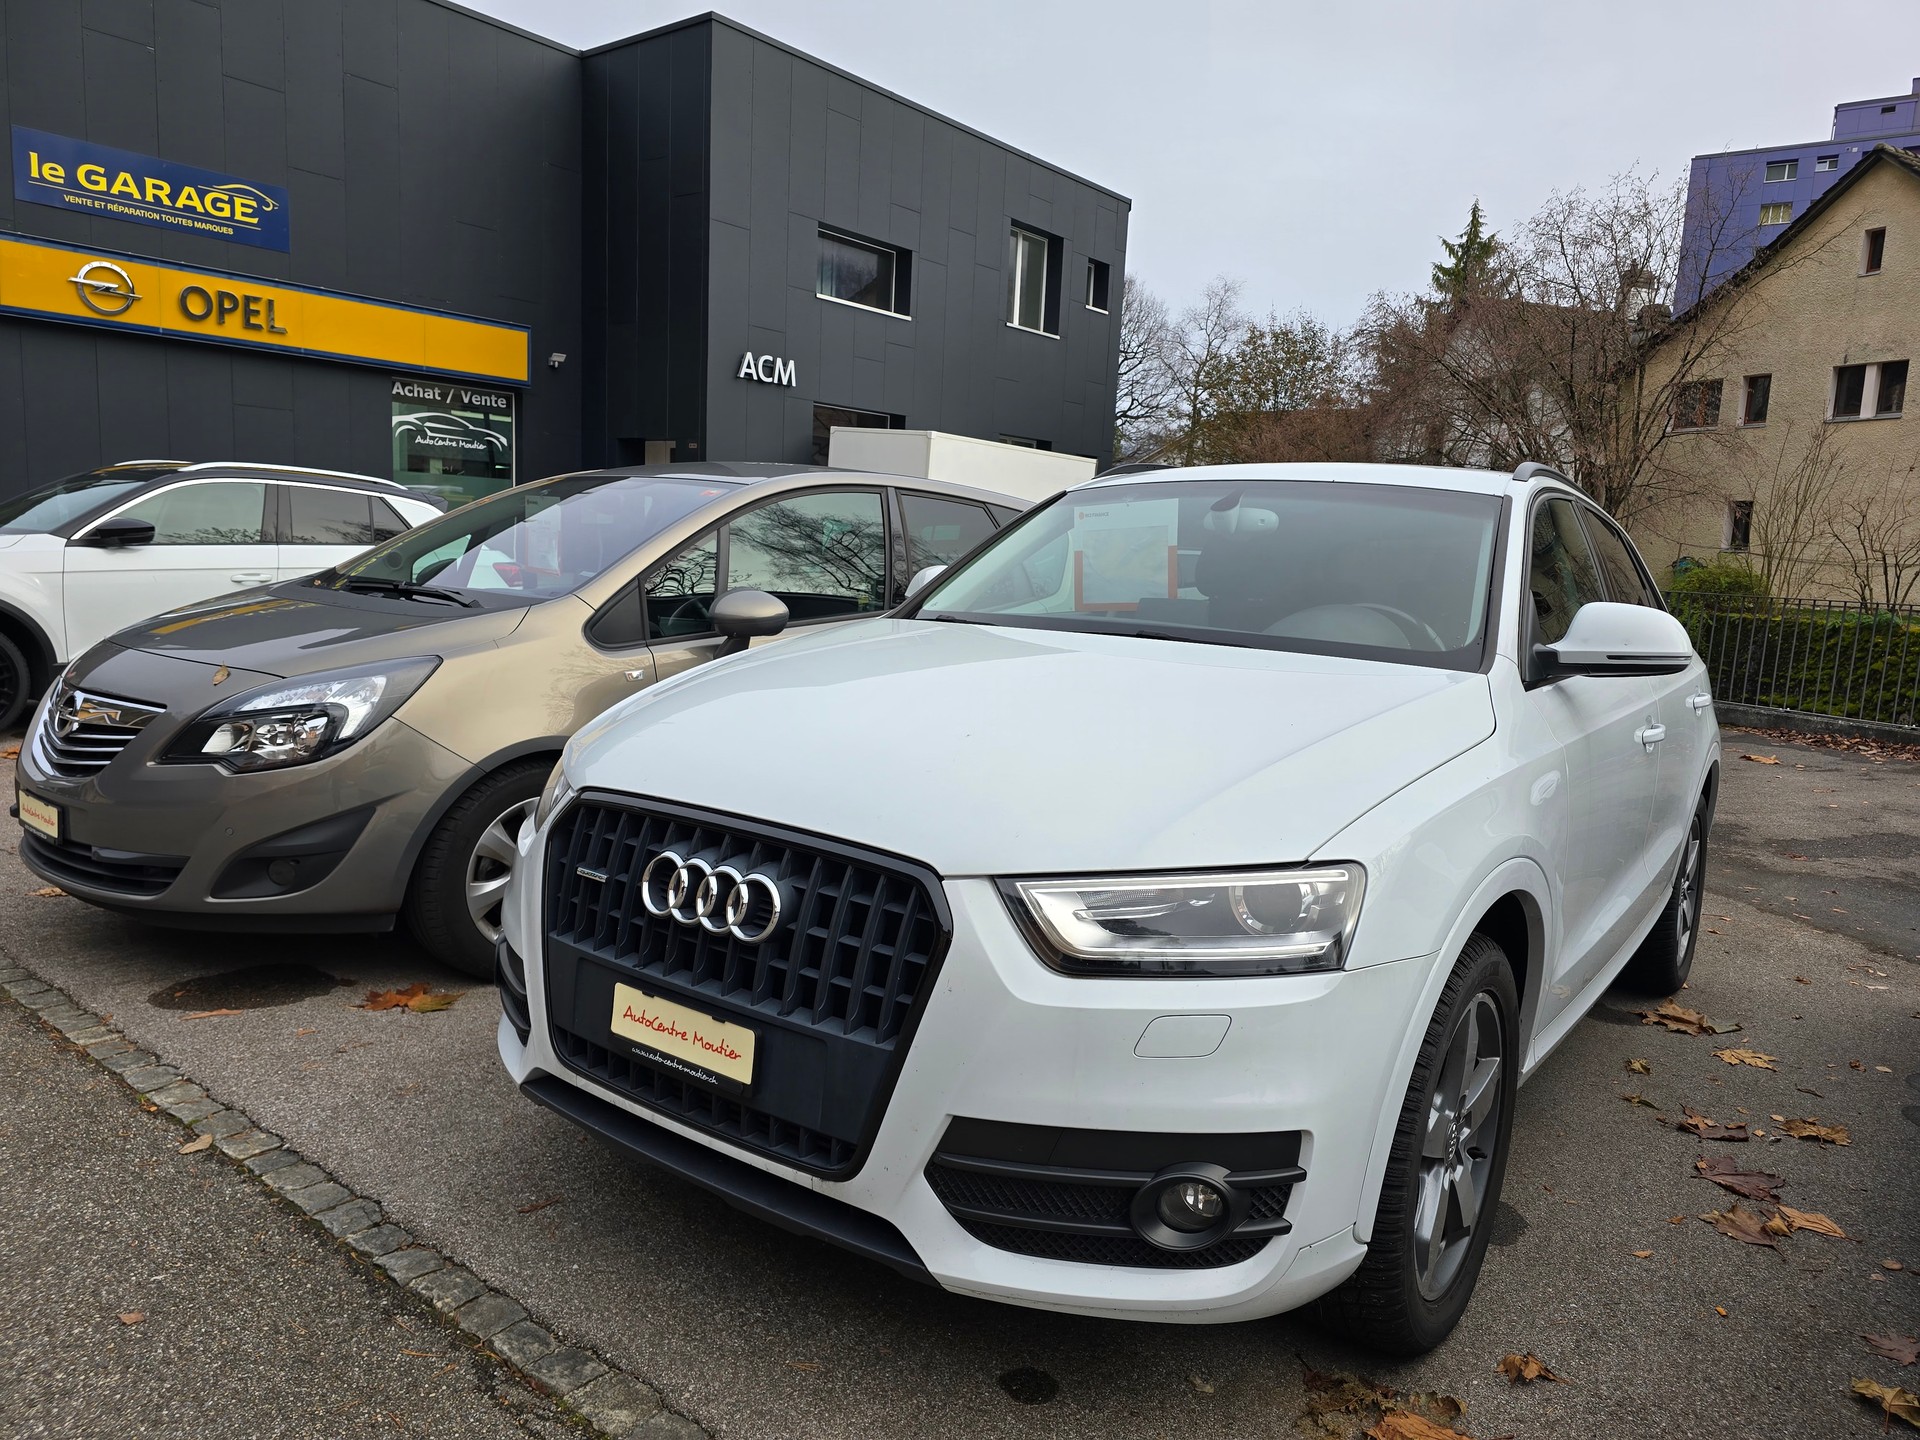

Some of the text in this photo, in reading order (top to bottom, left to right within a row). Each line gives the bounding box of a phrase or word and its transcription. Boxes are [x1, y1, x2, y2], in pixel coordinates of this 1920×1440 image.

[28, 151, 260, 224] le GARAGE
[63, 194, 234, 236] VENTE ET RÉPARATION TOUTES MARQUES
[179, 285, 289, 335] OPEL
[737, 351, 797, 387] ACM
[392, 382, 507, 408] Achat / Vente
[415, 435, 487, 450] AutoCentre Moutier
[622, 1005, 743, 1061] AutoCentre Moutier
